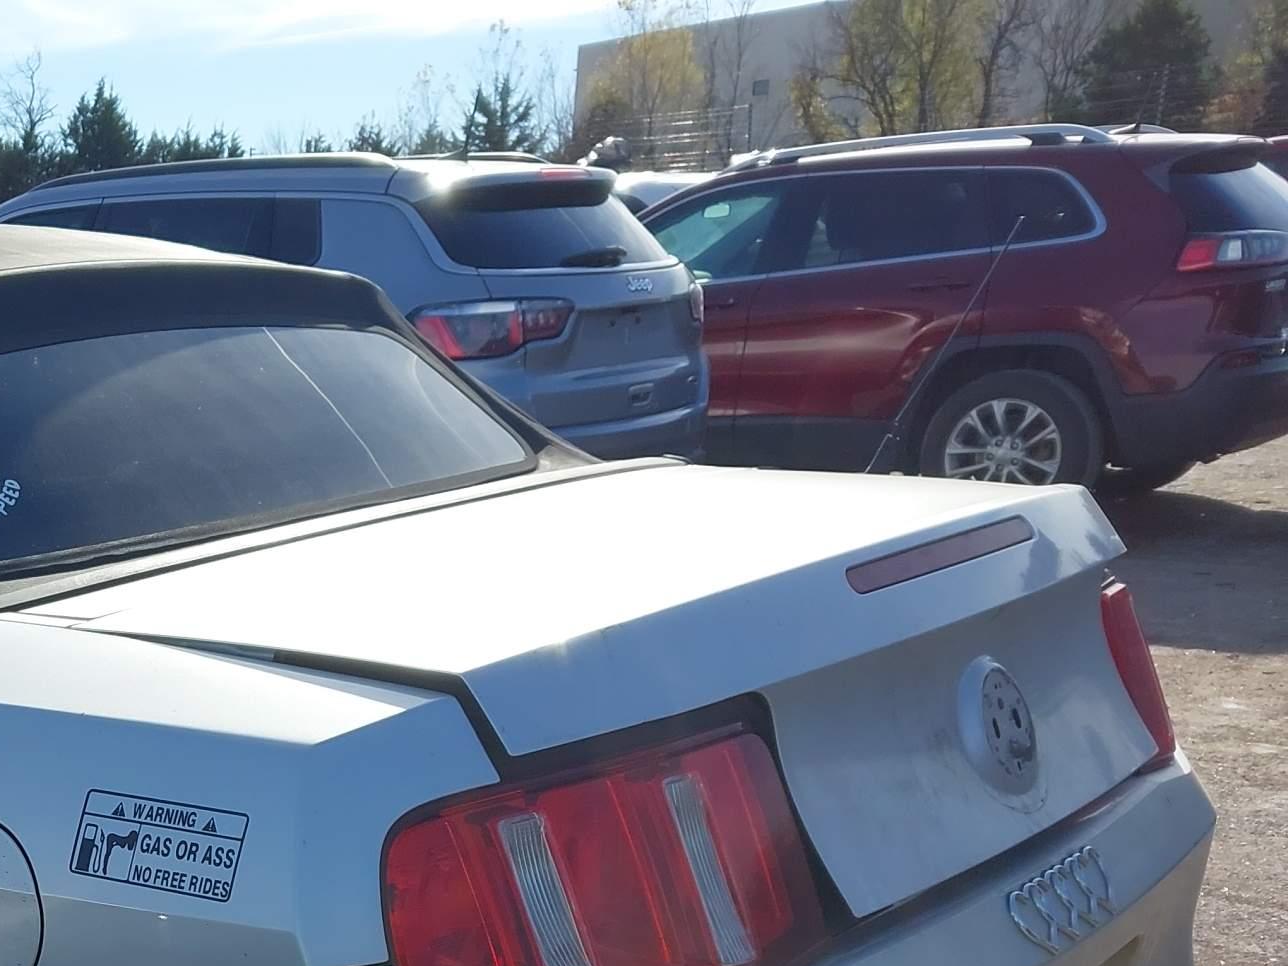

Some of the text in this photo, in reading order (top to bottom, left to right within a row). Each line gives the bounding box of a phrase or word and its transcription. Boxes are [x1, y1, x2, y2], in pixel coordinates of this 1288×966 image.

[627, 276, 653, 292] Jeep
[132, 802, 198, 828] WARNING
[140, 833, 235, 869] GAS OR ASS
[132, 865, 230, 898] NO FREE RIDES
